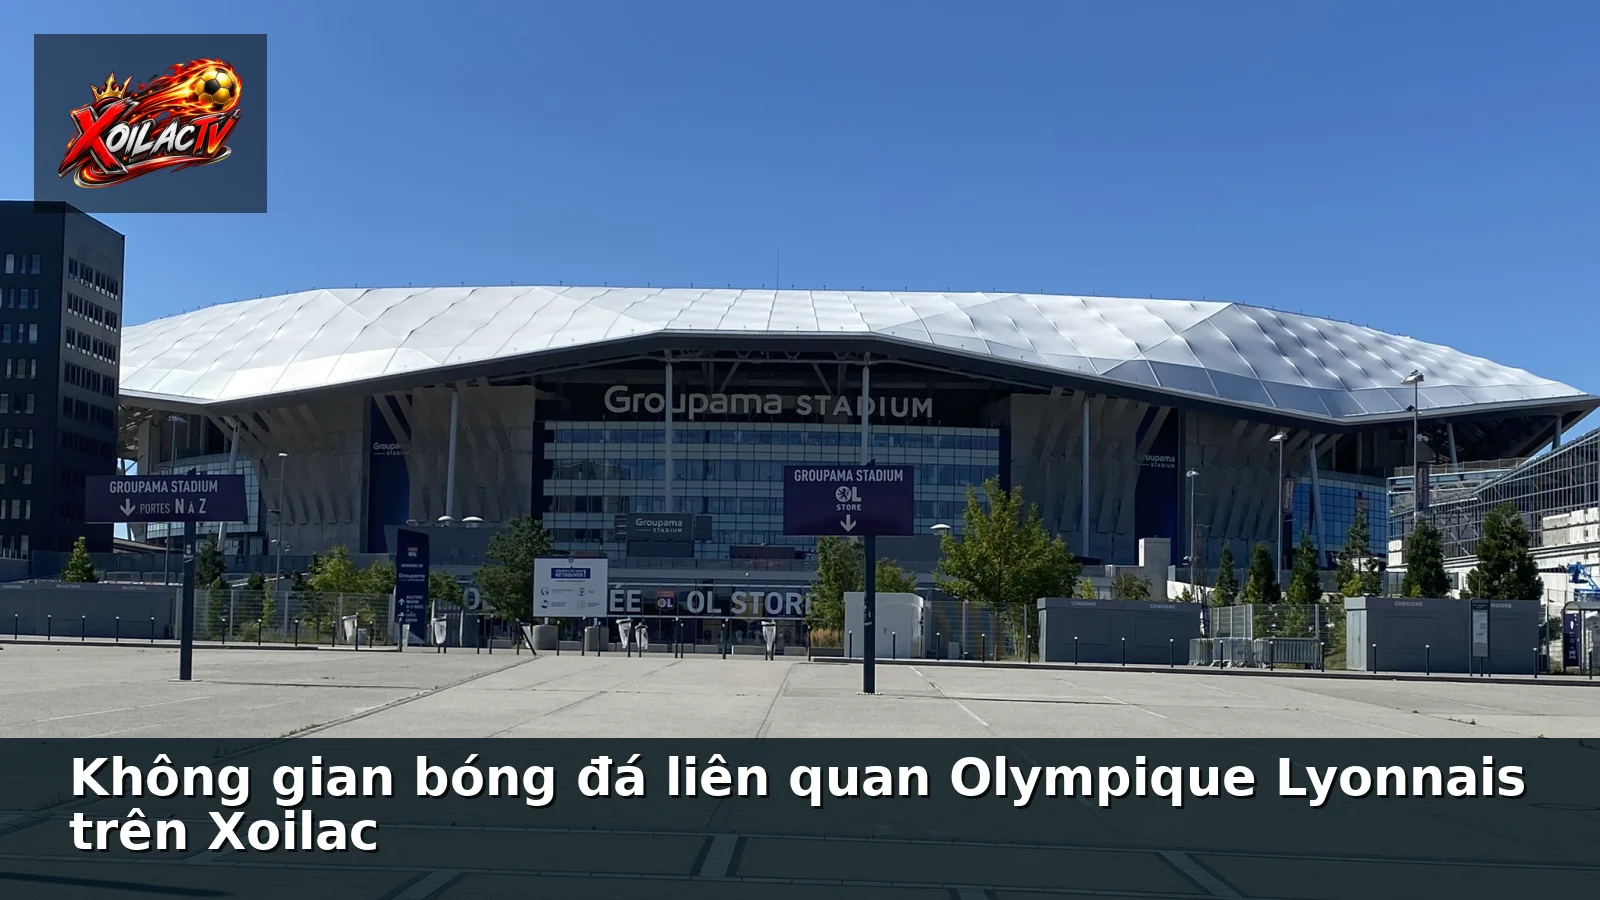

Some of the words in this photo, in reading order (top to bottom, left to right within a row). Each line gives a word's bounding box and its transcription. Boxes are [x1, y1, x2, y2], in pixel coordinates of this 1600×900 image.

[604, 385, 782, 420] Groupama
[796, 394, 932, 418] STADIUM
[373, 442, 403, 450] Groupa
[1145, 454, 1175, 462] oupama
[794, 469, 853, 482] GROUPAMA
[856, 469, 903, 482] STADIUM
[109, 480, 168, 493] GROUPAMA
[171, 480, 218, 493] STADIUM
[835, 486, 862, 503] OL
[139, 503, 170, 514] PORTES
[175, 499, 184, 514] N
[199, 498, 206, 514] Z
[836, 503, 862, 511] STORE
[636, 518, 682, 527] Groupama
[686, 590, 721, 614] OL
